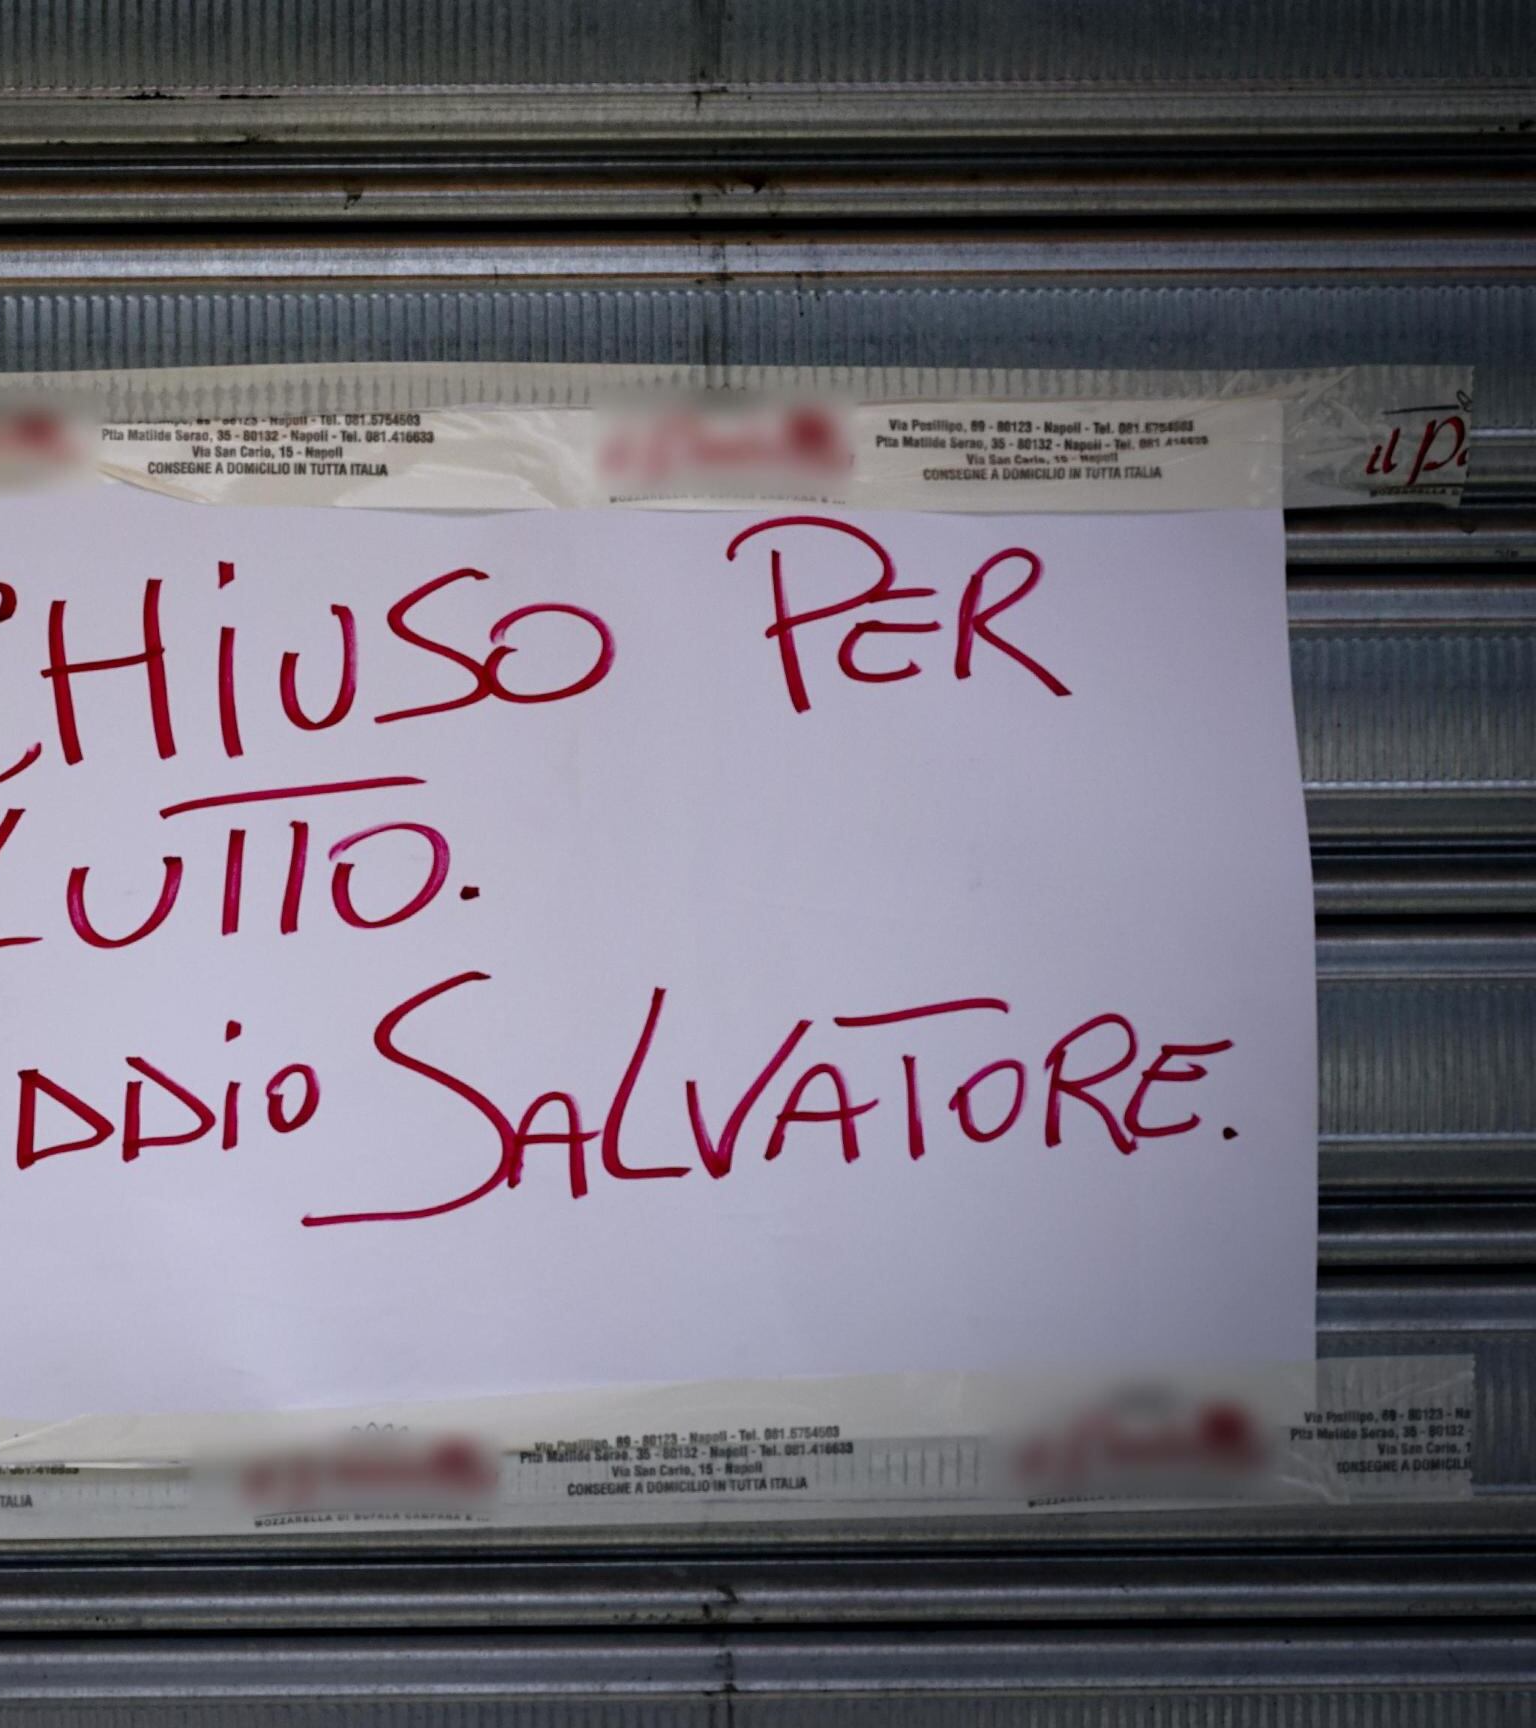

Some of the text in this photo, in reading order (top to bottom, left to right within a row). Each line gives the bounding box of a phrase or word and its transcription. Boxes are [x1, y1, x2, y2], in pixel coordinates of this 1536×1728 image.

[320, 414, 341, 426] Tel.
[889, 419, 908, 432] Via
[1044, 421, 1082, 435] Napoli
[1092, 422, 1114, 434] Tel.
[127, 429, 172, 441] Matilde
[217, 429, 232, 441] 35
[243, 430, 280, 442] 80132
[290, 430, 328, 443] Napoli
[340, 430, 362, 443] Tel.
[902, 436, 946, 449] Matilde
[991, 437, 1005, 450] 35
[1064, 439, 1102, 452] Napoli
[1114, 438, 1135, 451] Tel.
[192, 446, 343, 460] Via San Carlo, 15 Napoli
[966, 453, 985, 465] Via
[988, 454, 1011, 465] San
[1080, 452, 1118, 465] Napoli
[147, 462, 389, 476] CONSEGNE A DOMICILIO IN TUTTA ITALIA
[923, 466, 1163, 481] CONSEGNE A DOMICILIO IN TUTTA ITALIA
[726, 516, 1072, 713] PER
[302, 971, 1239, 1226] SALVATORE.
[1304, 1411, 1323, 1423] Via
[689, 1431, 727, 1445] Napoli
[738, 1429, 760, 1441] Tel.
[710, 1445, 748, 1460] Napoli
[760, 1444, 782, 1457] Tel.
[1377, 1443, 1397, 1456] Via
[1400, 1443, 1423, 1455] San
[611, 1465, 631, 1477] Via
[634, 1464, 656, 1477] San
[699, 1463, 713, 1475] 15
[725, 1461, 763, 1475] Napoli
[1337, 1460, 1398, 1473] CONSEGNE
[1401, 1460, 1410, 1472] A
[567, 1477, 808, 1496] CONSEGNE A DOMICILIO IN TUTTA ITALIA
